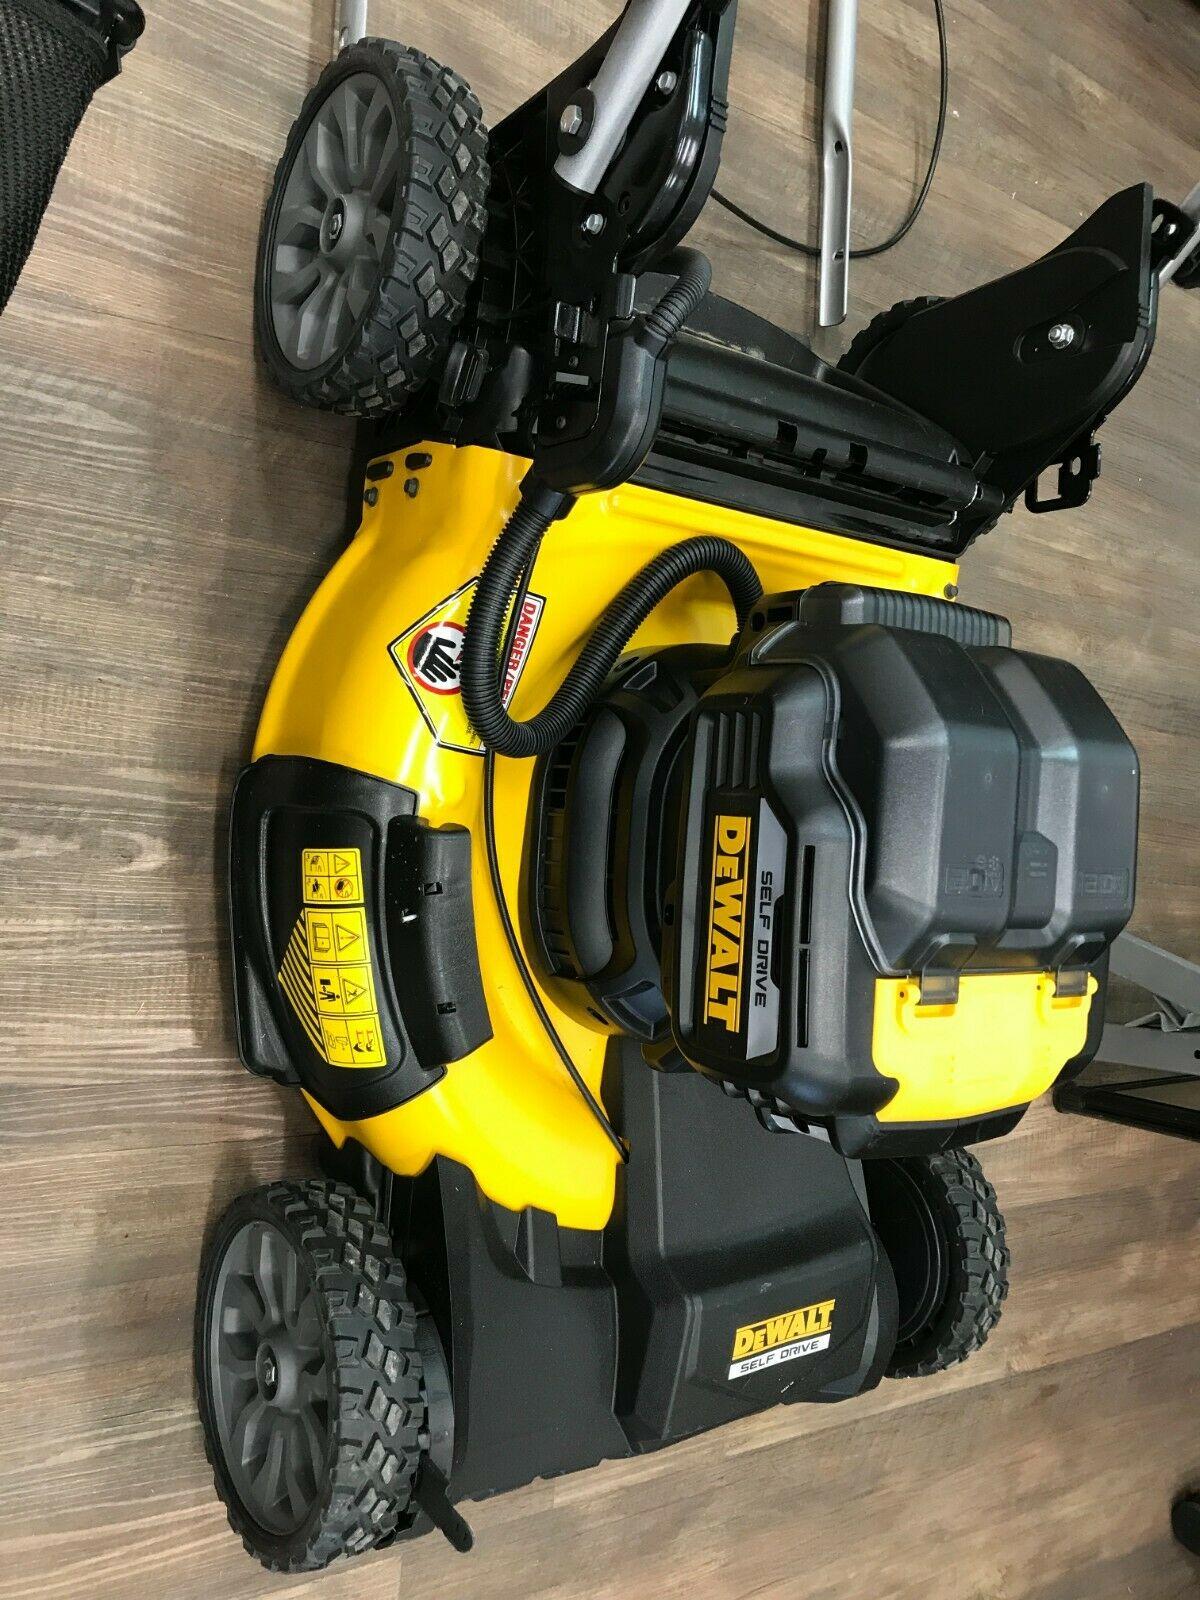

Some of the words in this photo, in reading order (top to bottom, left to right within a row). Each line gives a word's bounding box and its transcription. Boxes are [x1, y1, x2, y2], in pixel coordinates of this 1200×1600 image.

[706, 815, 749, 1033] DEWALT
[759, 870, 773, 930] SELF
[754, 939, 769, 1008] DRIVE
[732, 1301, 835, 1358] DEWALT
[740, 1353, 775, 1374] SELF
[780, 1340, 820, 1360] DRIVE
